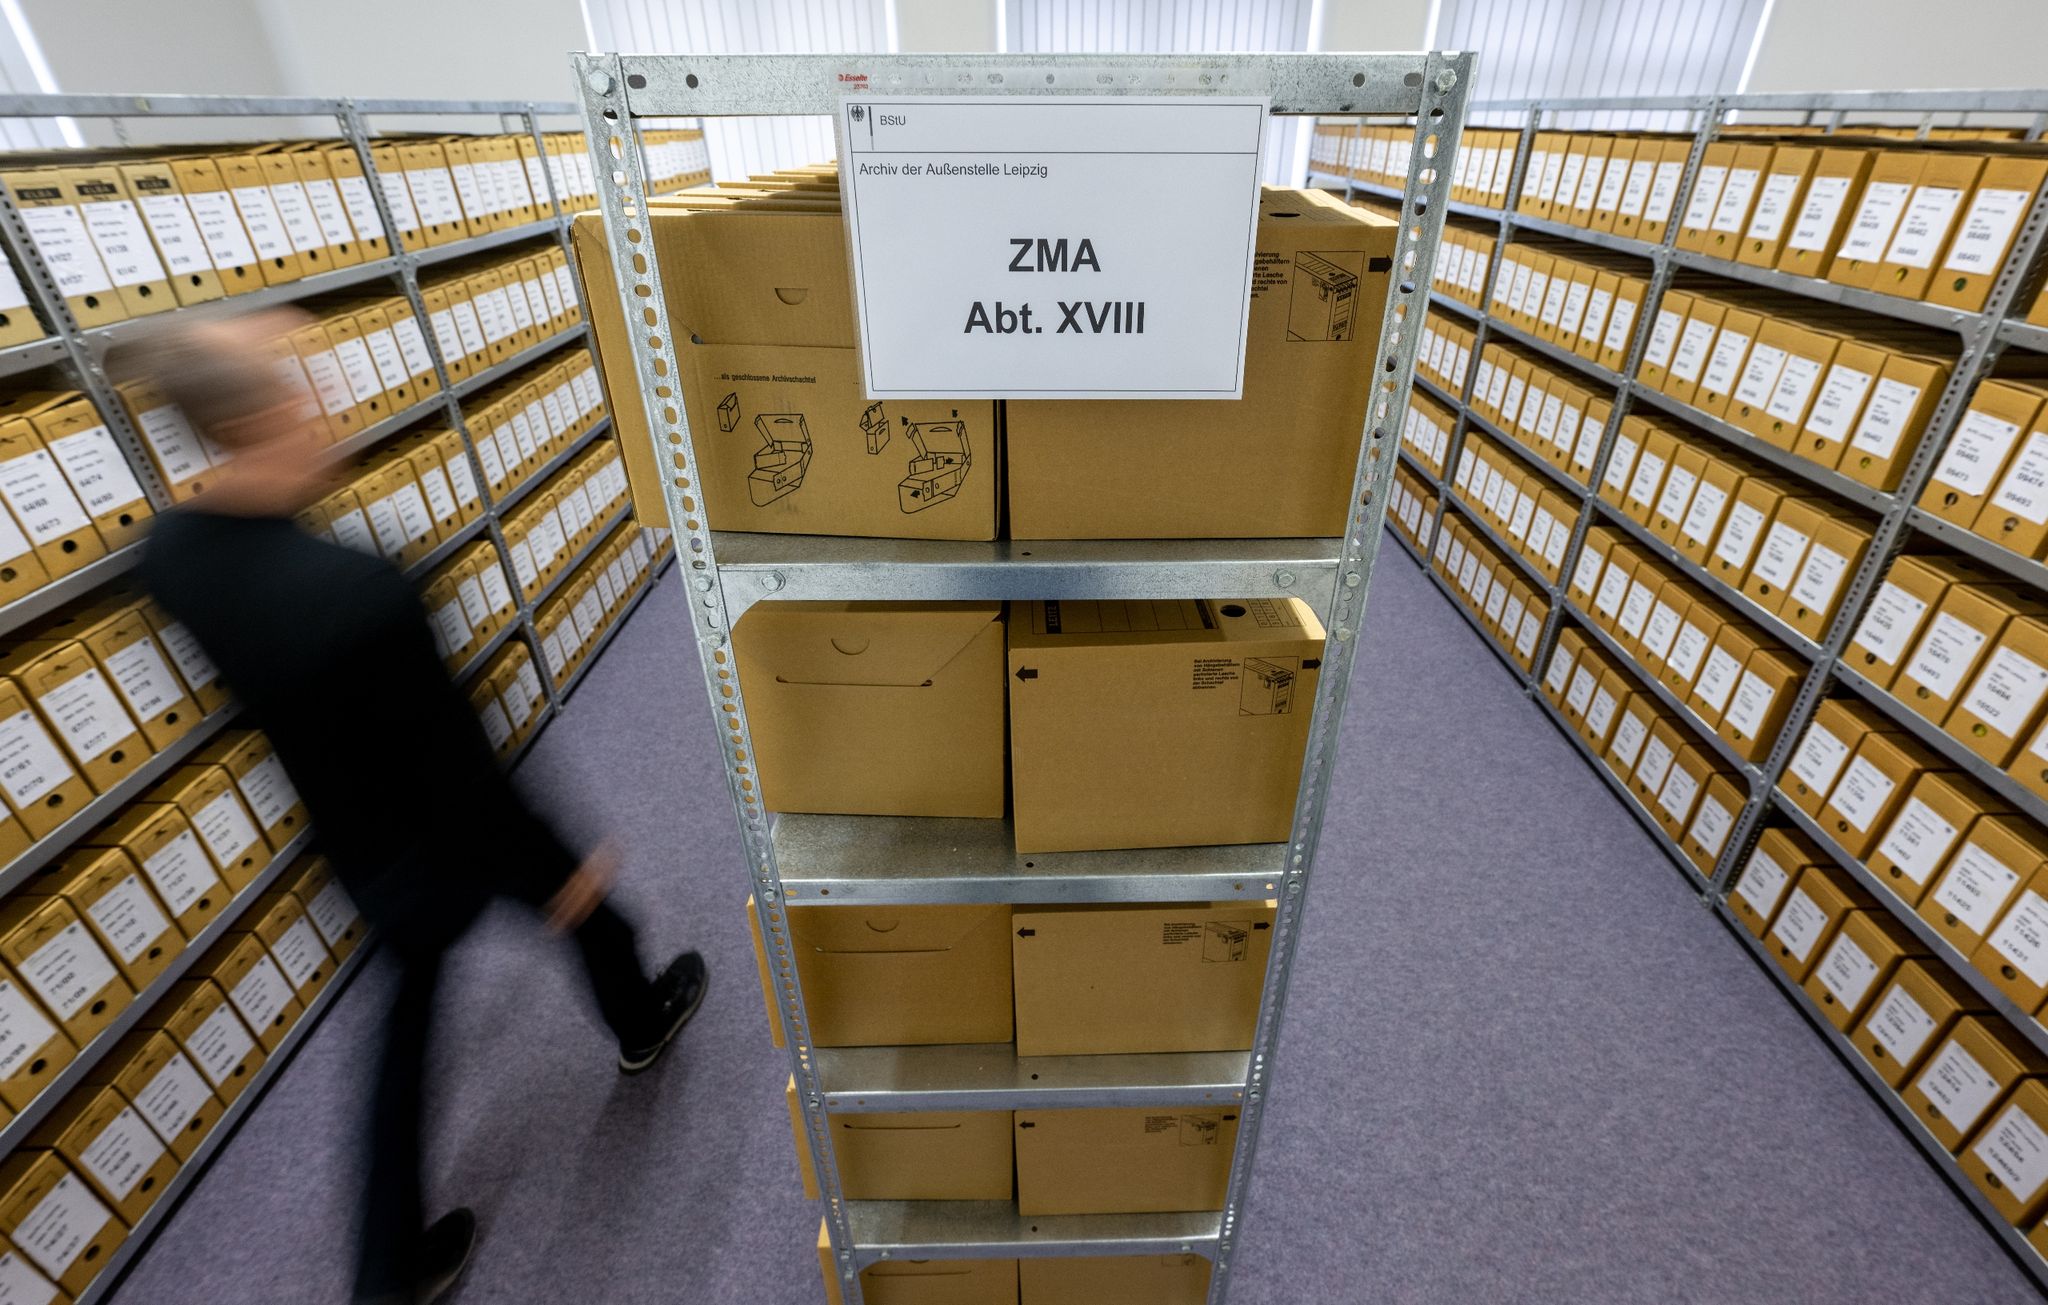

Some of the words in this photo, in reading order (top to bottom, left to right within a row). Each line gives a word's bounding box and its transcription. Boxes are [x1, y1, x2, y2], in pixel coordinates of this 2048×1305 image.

[844, 73, 868, 82] Esselte
[879, 115, 906, 126] BStU
[859, 162, 898, 176] Archiv
[901, 162, 923, 176] der
[925, 162, 1000, 176] Außenstelle
[1003, 162, 1048, 179] Leipzig
[1008, 238, 1102, 273] ZMA
[963, 301, 1043, 334] Abt.
[1055, 301, 1146, 334] XVIII
[731, 374, 771, 382] geschlossene
